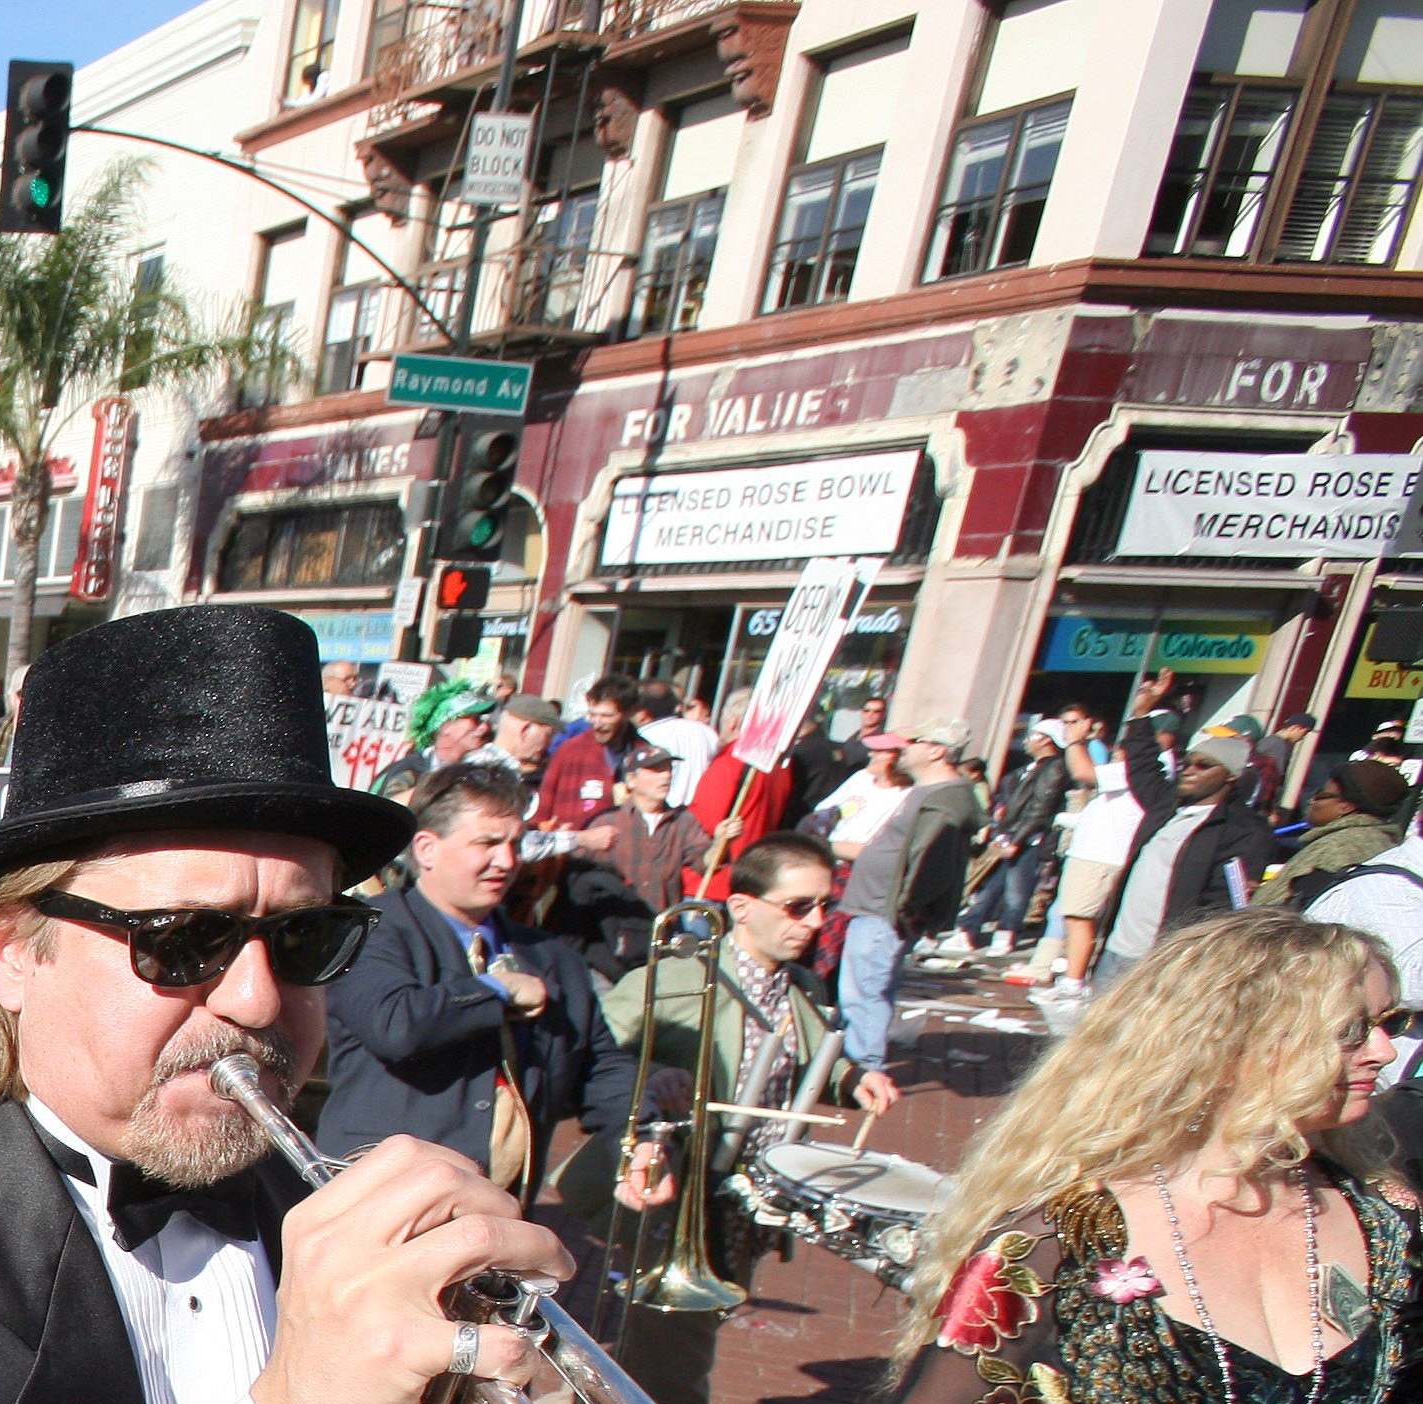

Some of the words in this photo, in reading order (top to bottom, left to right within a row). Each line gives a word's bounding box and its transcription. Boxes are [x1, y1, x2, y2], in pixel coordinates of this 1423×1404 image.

[476, 126, 495, 146] DO
[501, 124, 528, 148] NOT
[470, 157, 523, 175] BLOCK
[394, 368, 488, 397] Raymond
[497, 376, 525, 401] Av
[1225, 358, 1330, 405] FOR
[620, 403, 693, 448] FOR
[621, 486, 732, 516] LICENSED
[739, 479, 809, 508] ROSE
[818, 469, 899, 500] BOWL
[1143, 469, 1296, 497] LICENSED
[1307, 471, 1395, 497] ROSE
[654, 514, 838, 549] MERCHANDISE
[1192, 513, 1403, 541] MERCHANDIS
[747, 608, 782, 636] 65
[1070, 625, 1105, 659] 65
[1161, 632, 1256, 660] Colorado
[1367, 669, 1411, 689] BUY
